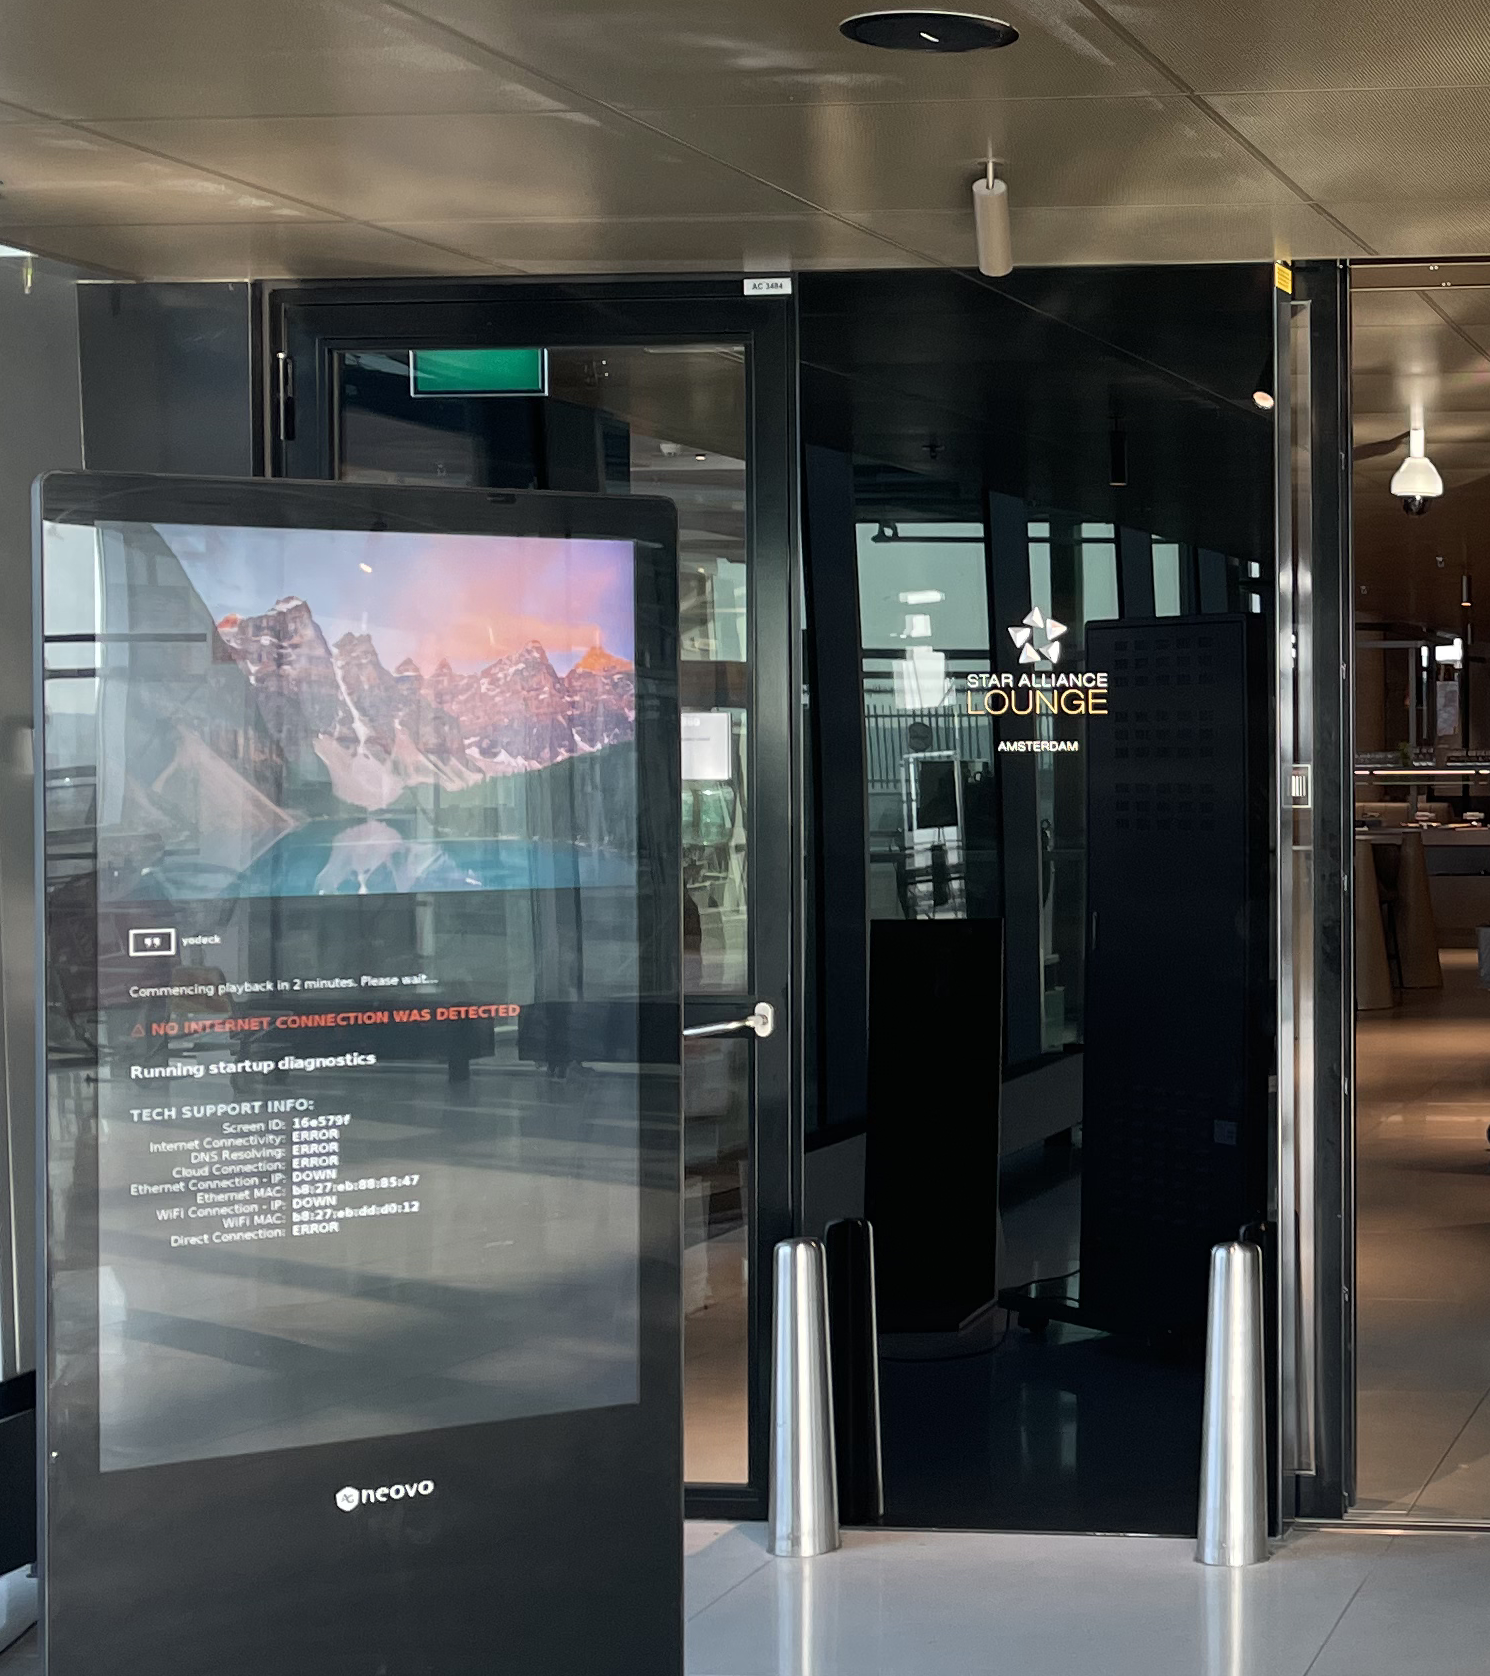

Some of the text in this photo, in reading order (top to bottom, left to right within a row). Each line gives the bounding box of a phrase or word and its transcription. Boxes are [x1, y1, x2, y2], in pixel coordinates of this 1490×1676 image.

[967, 673, 1108, 687] STAR ALLIANCE
[966, 689, 1108, 715] LOUNGE
[998, 741, 1079, 752] AMSTERDAM
[182, 934, 221, 946] yodeck
[129, 983, 215, 998] Commencing
[218, 980, 274, 995] playback
[277, 980, 289, 991] in
[292, 979, 301, 990] 2
[304, 977, 358, 989] minutes.
[361, 975, 399, 987] Please
[151, 1004, 520, 1036] NO INTERNET CONNECTION WAS DETECTED
[130, 1052, 377, 1079] Running startup diagnostics
[129, 1098, 315, 1122] TECH SUPPORT INFO:
[222, 1122, 265, 1134] Screen
[268, 1119, 286, 1131] ID:
[149, 1128, 340, 1153] Internet Connectivity: ERROR
[190, 1142, 340, 1164] DNS Resolving: ERROR
[172, 1155, 340, 1178] Cloud Connection: ERROR
[130, 1181, 185, 1196] Ethernet
[188, 1175, 259, 1190] Connection
[271, 1172, 286, 1184] IP:
[292, 1169, 338, 1182] DOWN
[196, 1189, 250, 1204] Ethernet
[253, 1186, 286, 1199] MAC:
[155, 1207, 185, 1221] WiFi
[188, 1203, 259, 1218] Connection
[271, 1199, 286, 1211] IP:
[292, 1195, 338, 1209] DOWN
[222, 1215, 250, 1229] WiFi
[253, 1212, 286, 1226] MAC:
[170, 1222, 340, 1247] Direct Connection: ERROR
[361, 1479, 435, 1504] neovo
